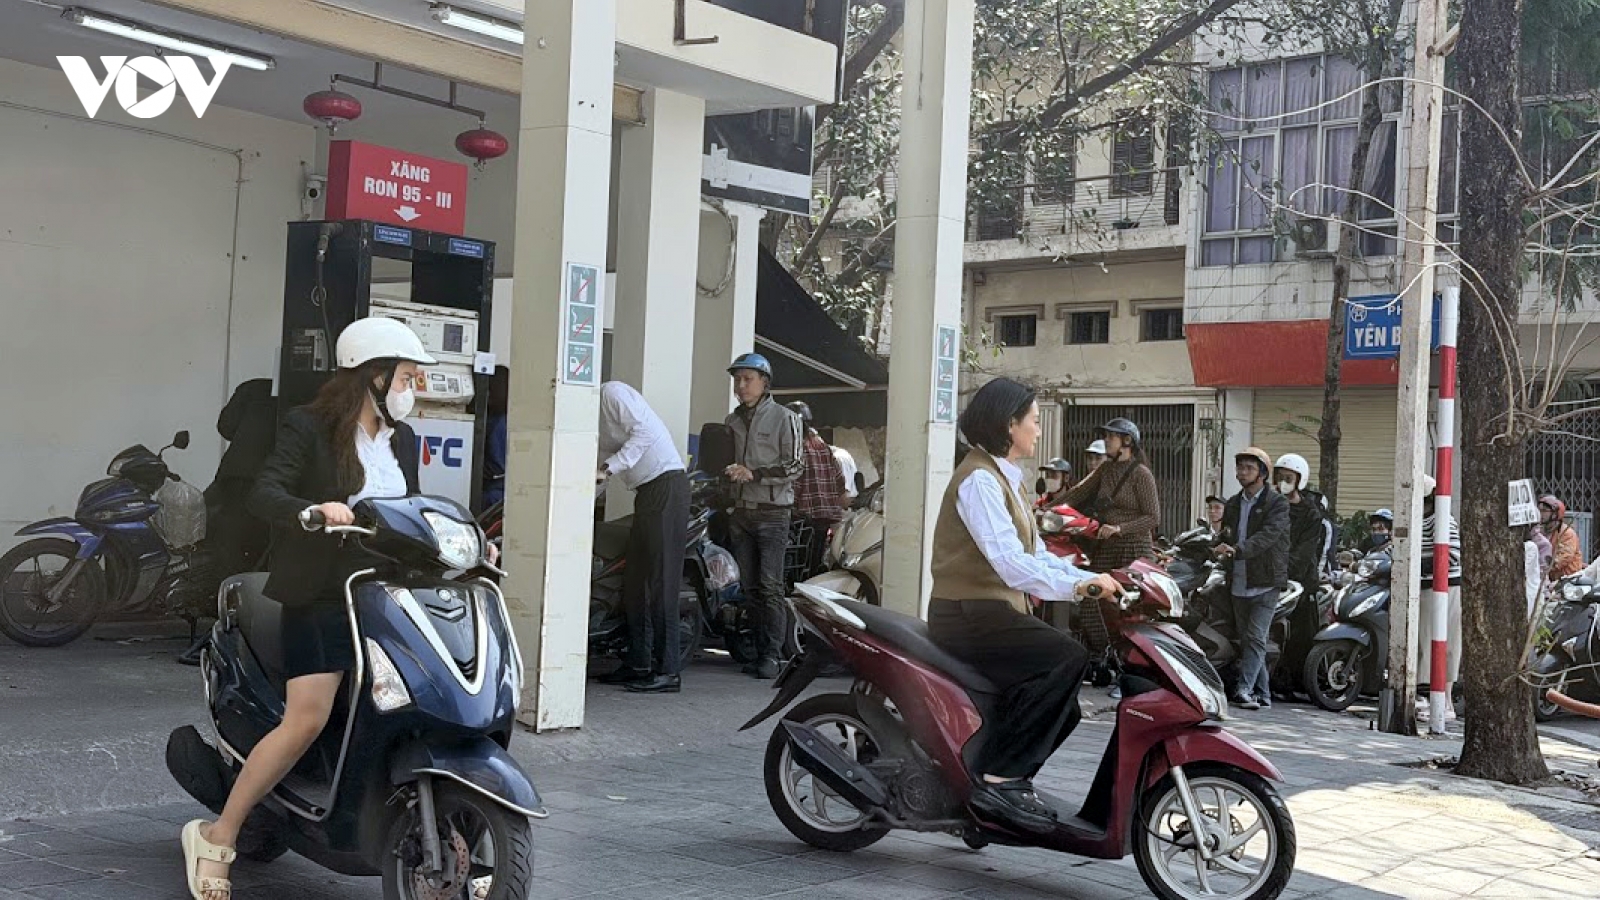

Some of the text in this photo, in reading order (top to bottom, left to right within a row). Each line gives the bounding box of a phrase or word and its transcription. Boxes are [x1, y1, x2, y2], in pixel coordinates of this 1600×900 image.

[390, 160, 431, 183] XĂNG
[364, 176, 398, 199] RON
[402, 184, 421, 203] 95
[435, 190, 452, 209] III
[1354, 322, 1386, 348] YÊN
